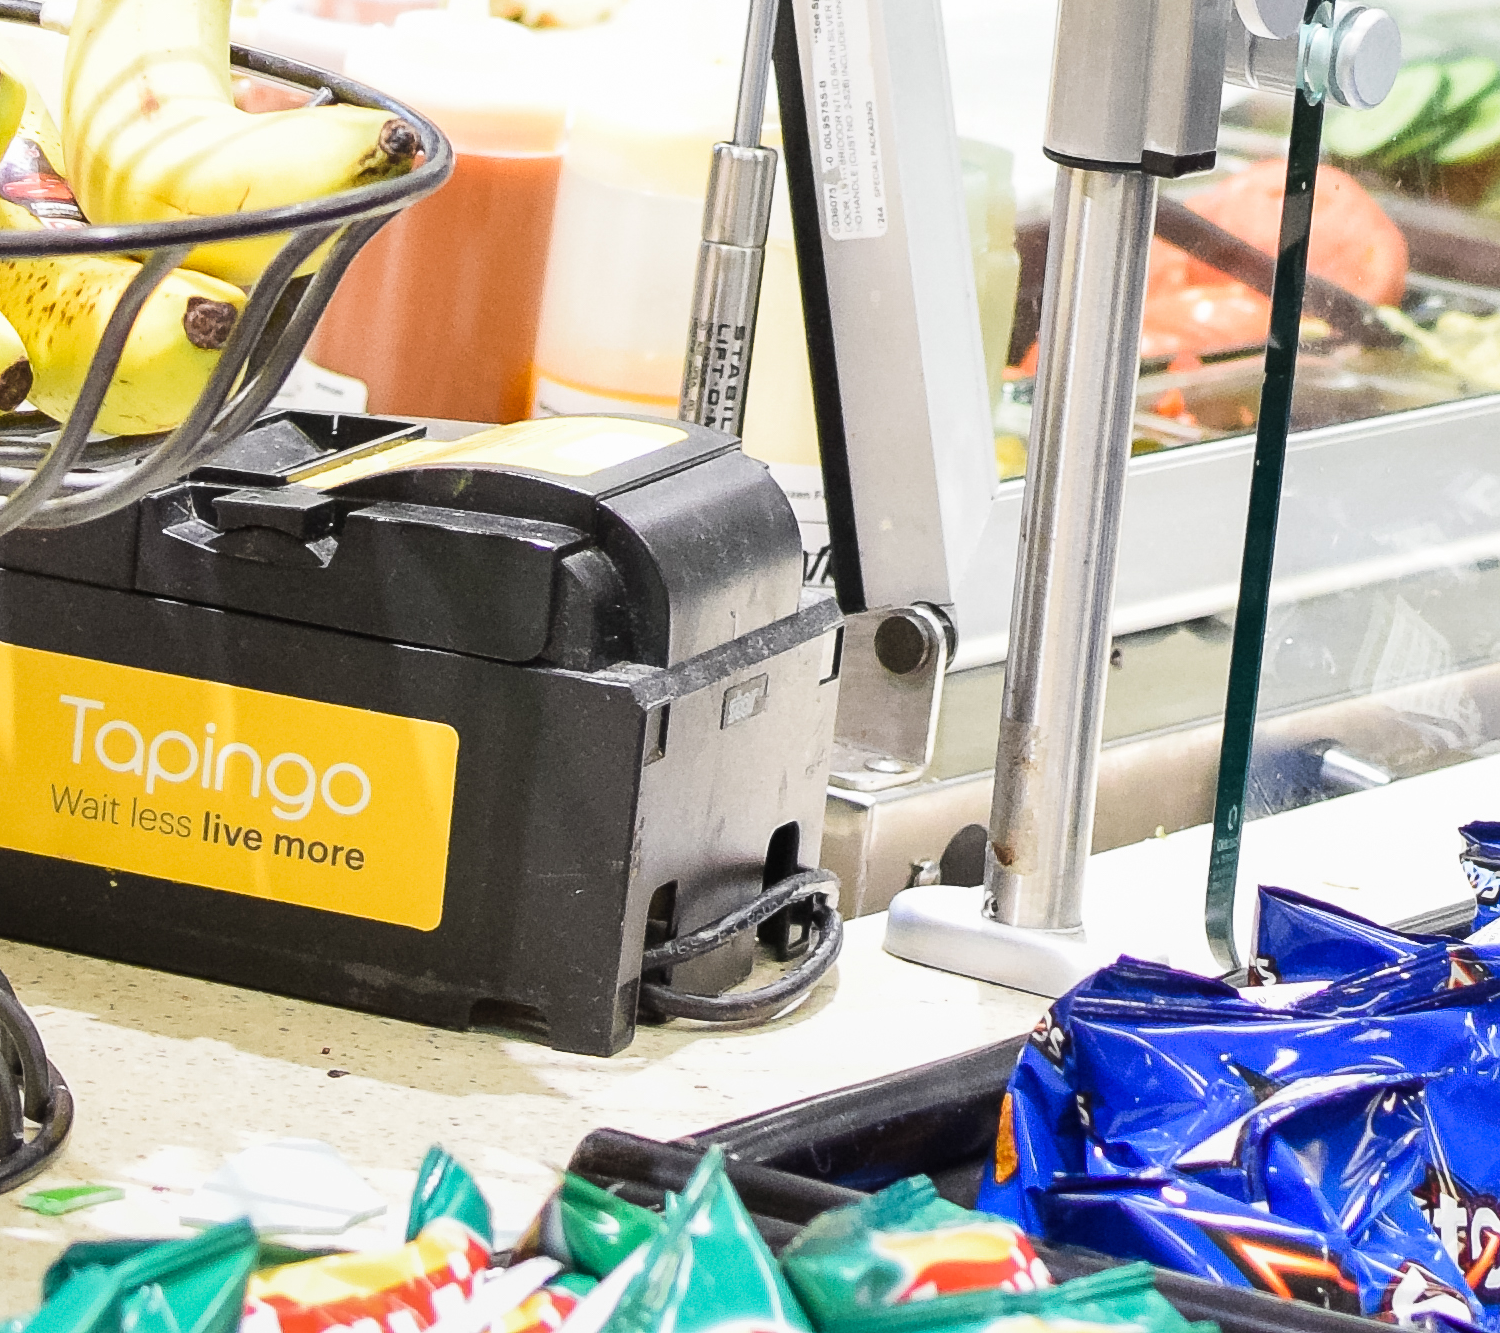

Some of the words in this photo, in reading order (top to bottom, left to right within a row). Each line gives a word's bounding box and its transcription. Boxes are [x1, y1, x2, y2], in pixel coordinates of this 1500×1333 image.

[59, 694, 371, 821] Tapingo
[51, 784, 119, 825] Wait
[131, 797, 191, 838] less
[203, 811, 262, 851] live
[274, 833, 365, 870] more
